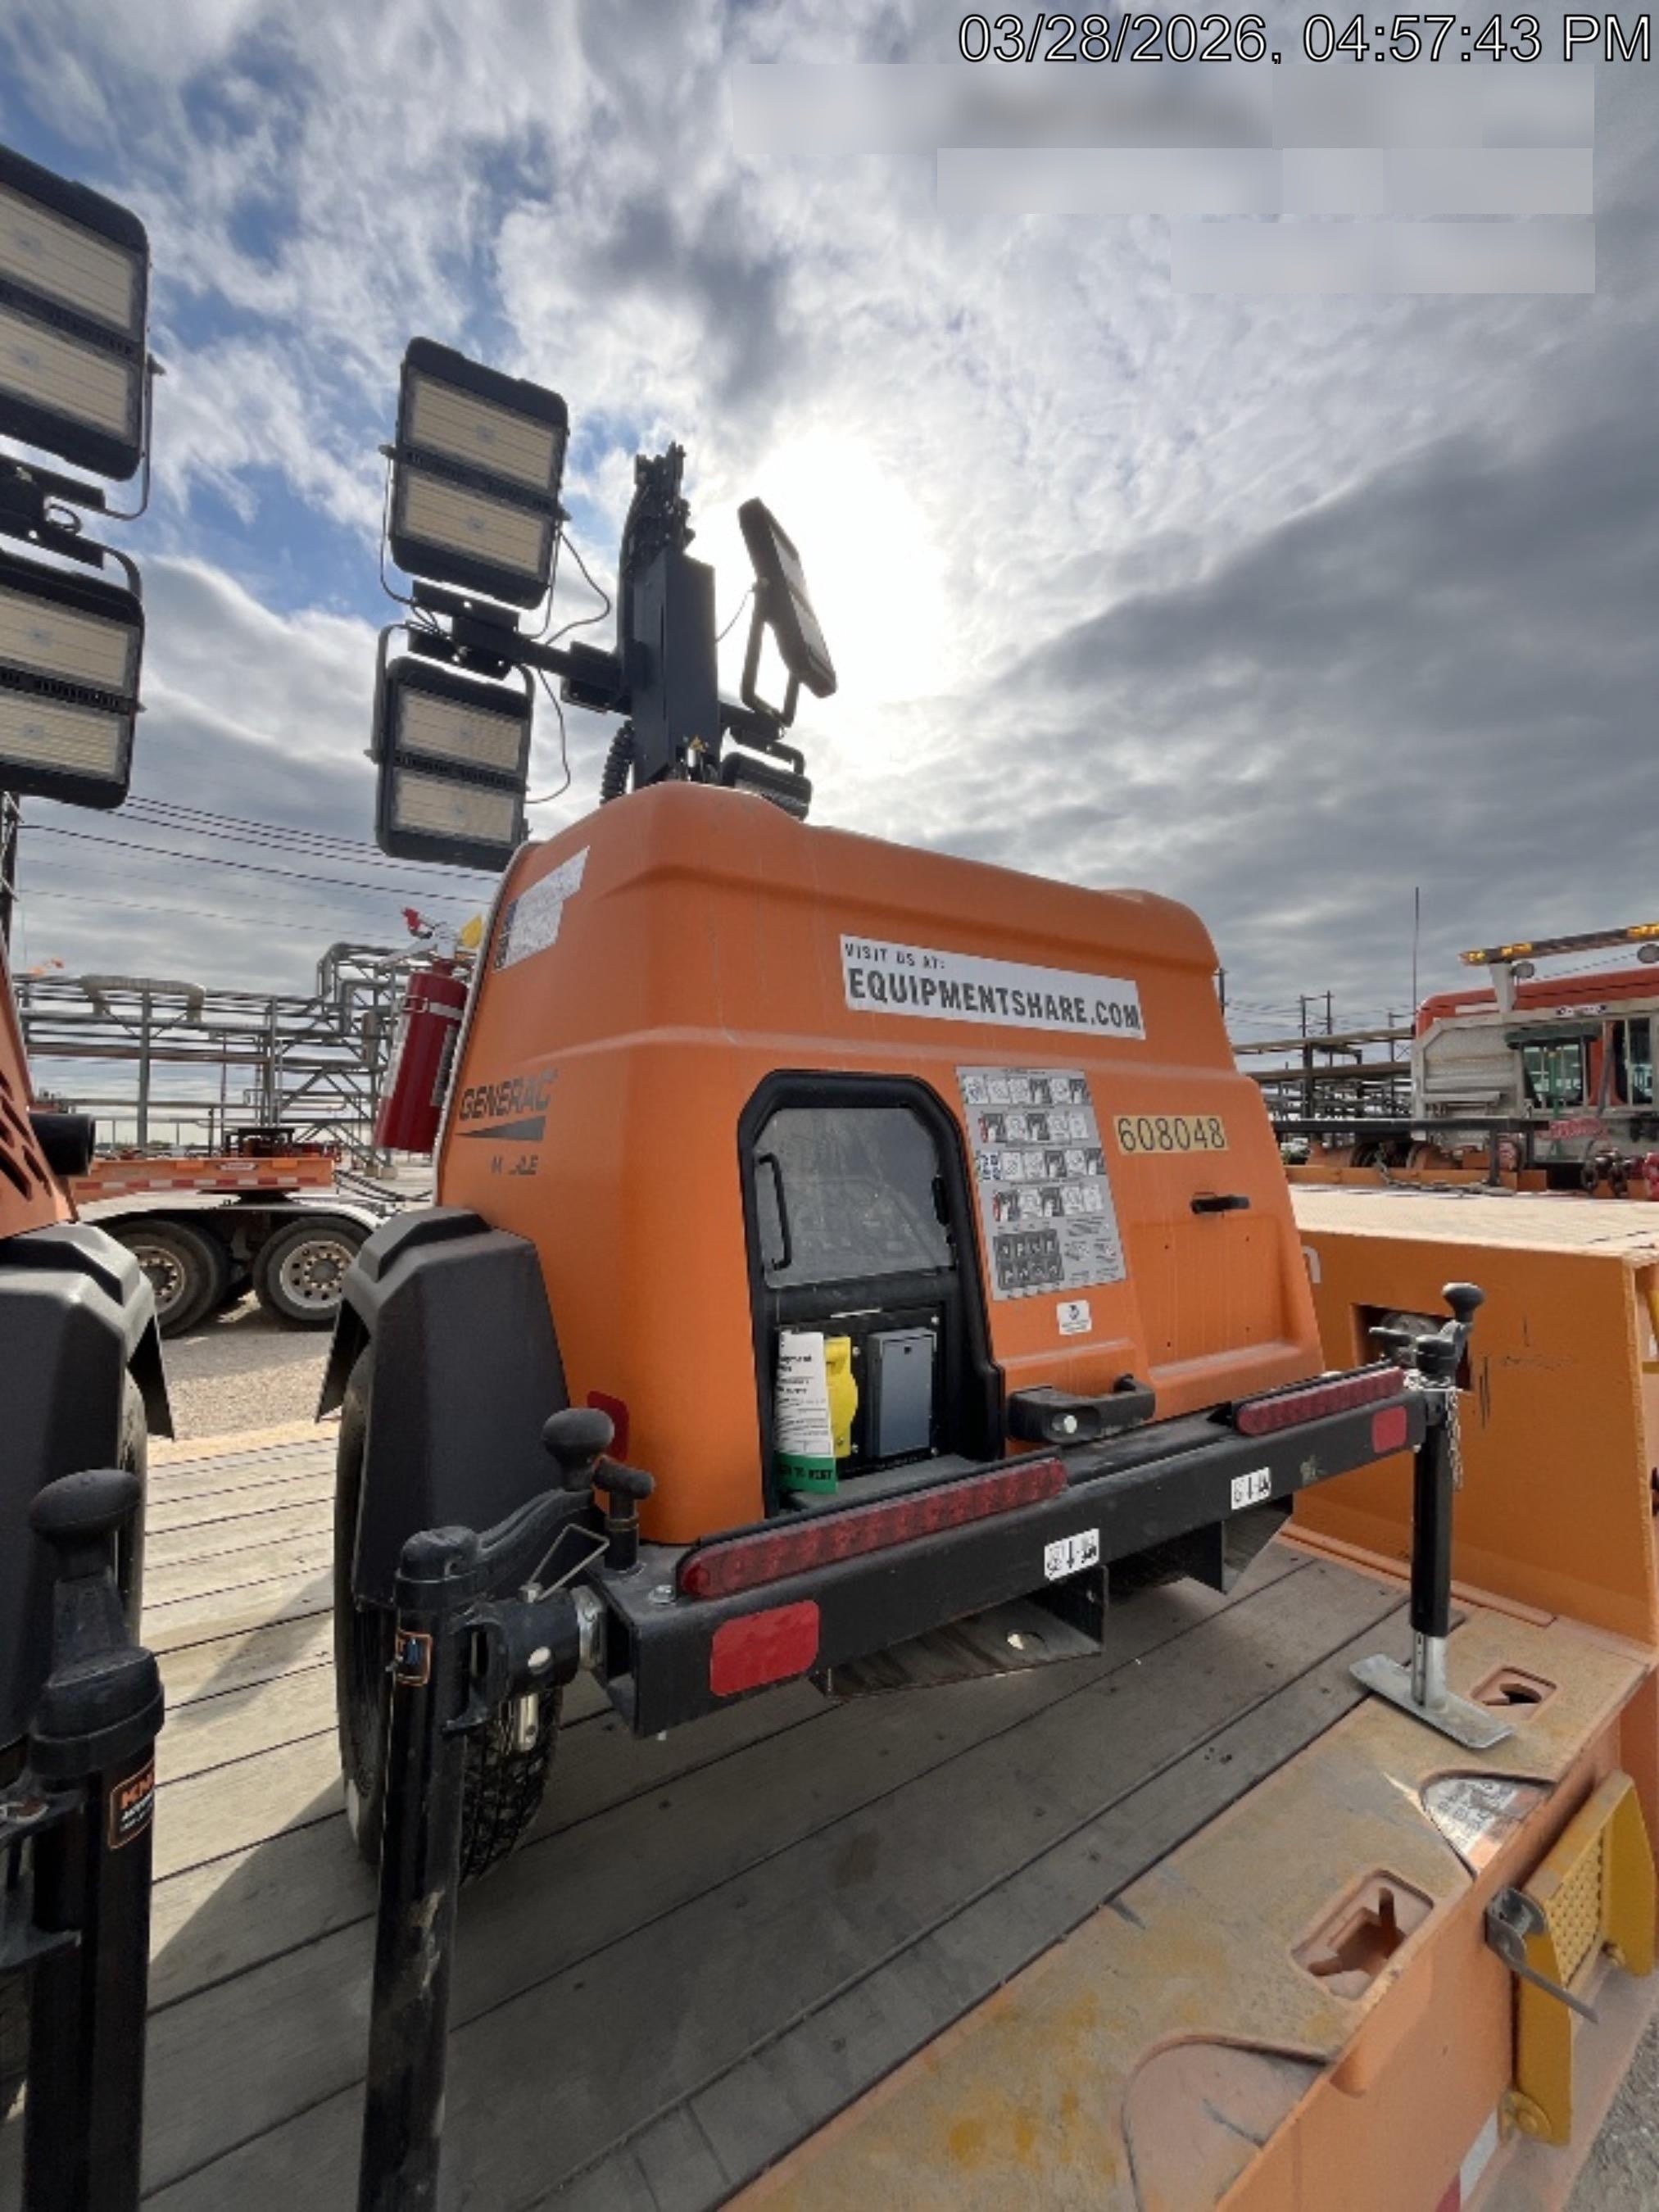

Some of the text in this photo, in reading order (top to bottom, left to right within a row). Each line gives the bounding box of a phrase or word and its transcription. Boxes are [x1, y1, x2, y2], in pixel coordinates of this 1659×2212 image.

[845, 943, 945, 970] VISIT US AT:
[848, 968, 1141, 1030] EQUIPMENTSHARE.COM
[1117, 1117, 1225, 1151] 608048
